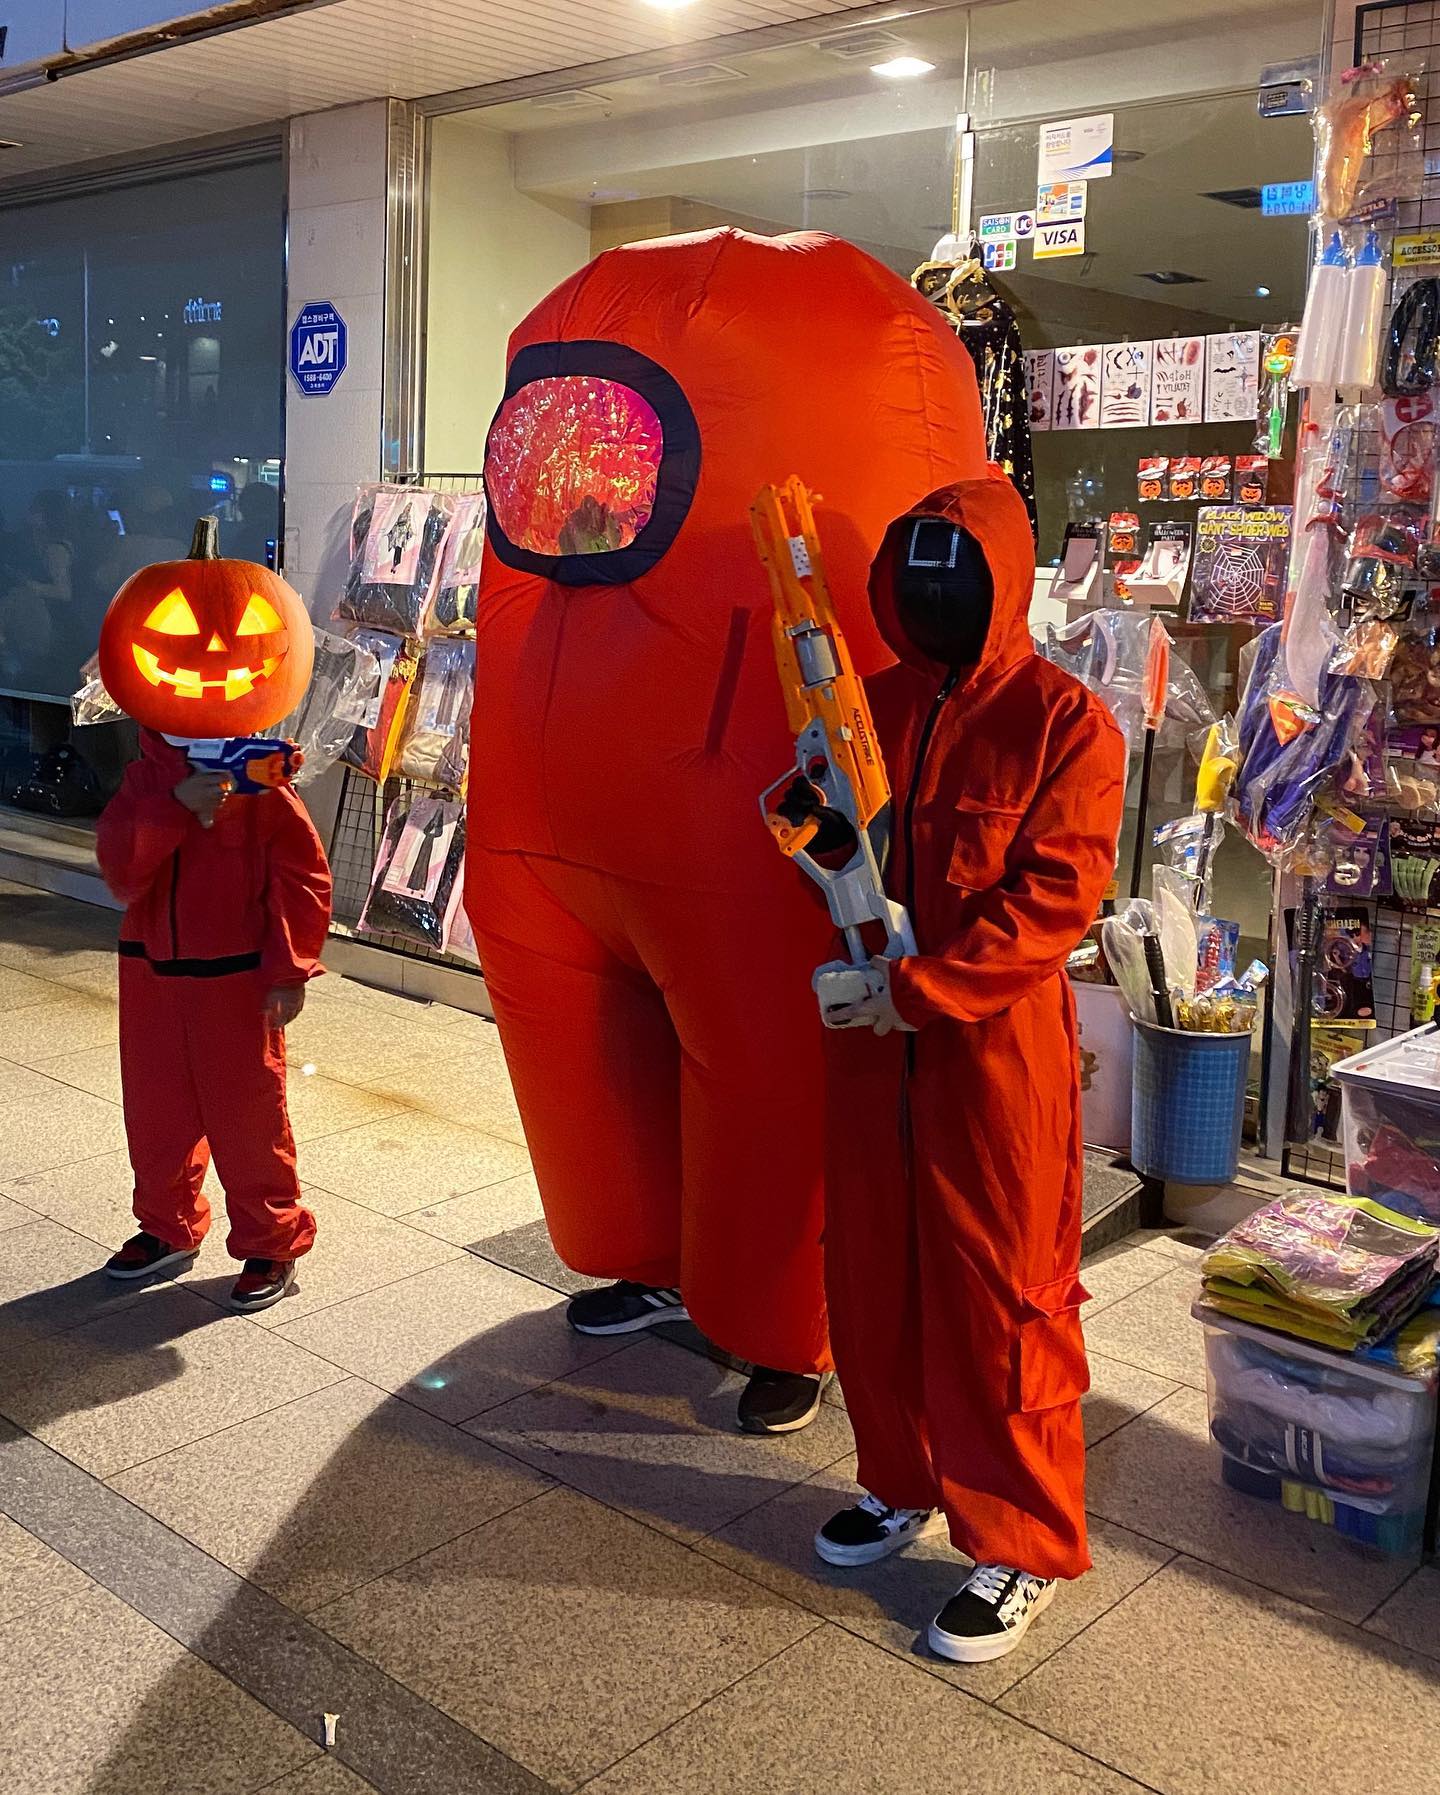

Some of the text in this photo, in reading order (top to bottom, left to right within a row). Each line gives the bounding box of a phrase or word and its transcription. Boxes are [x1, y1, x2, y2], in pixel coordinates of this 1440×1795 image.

[986, 225, 1007, 234] CARD
[1043, 229, 1078, 246] VISA
[300, 332, 338, 365] ADT
[1206, 511, 1284, 521] BLACK WIDOW
[1199, 522, 1289, 537] GIANT SPIDER WEB
